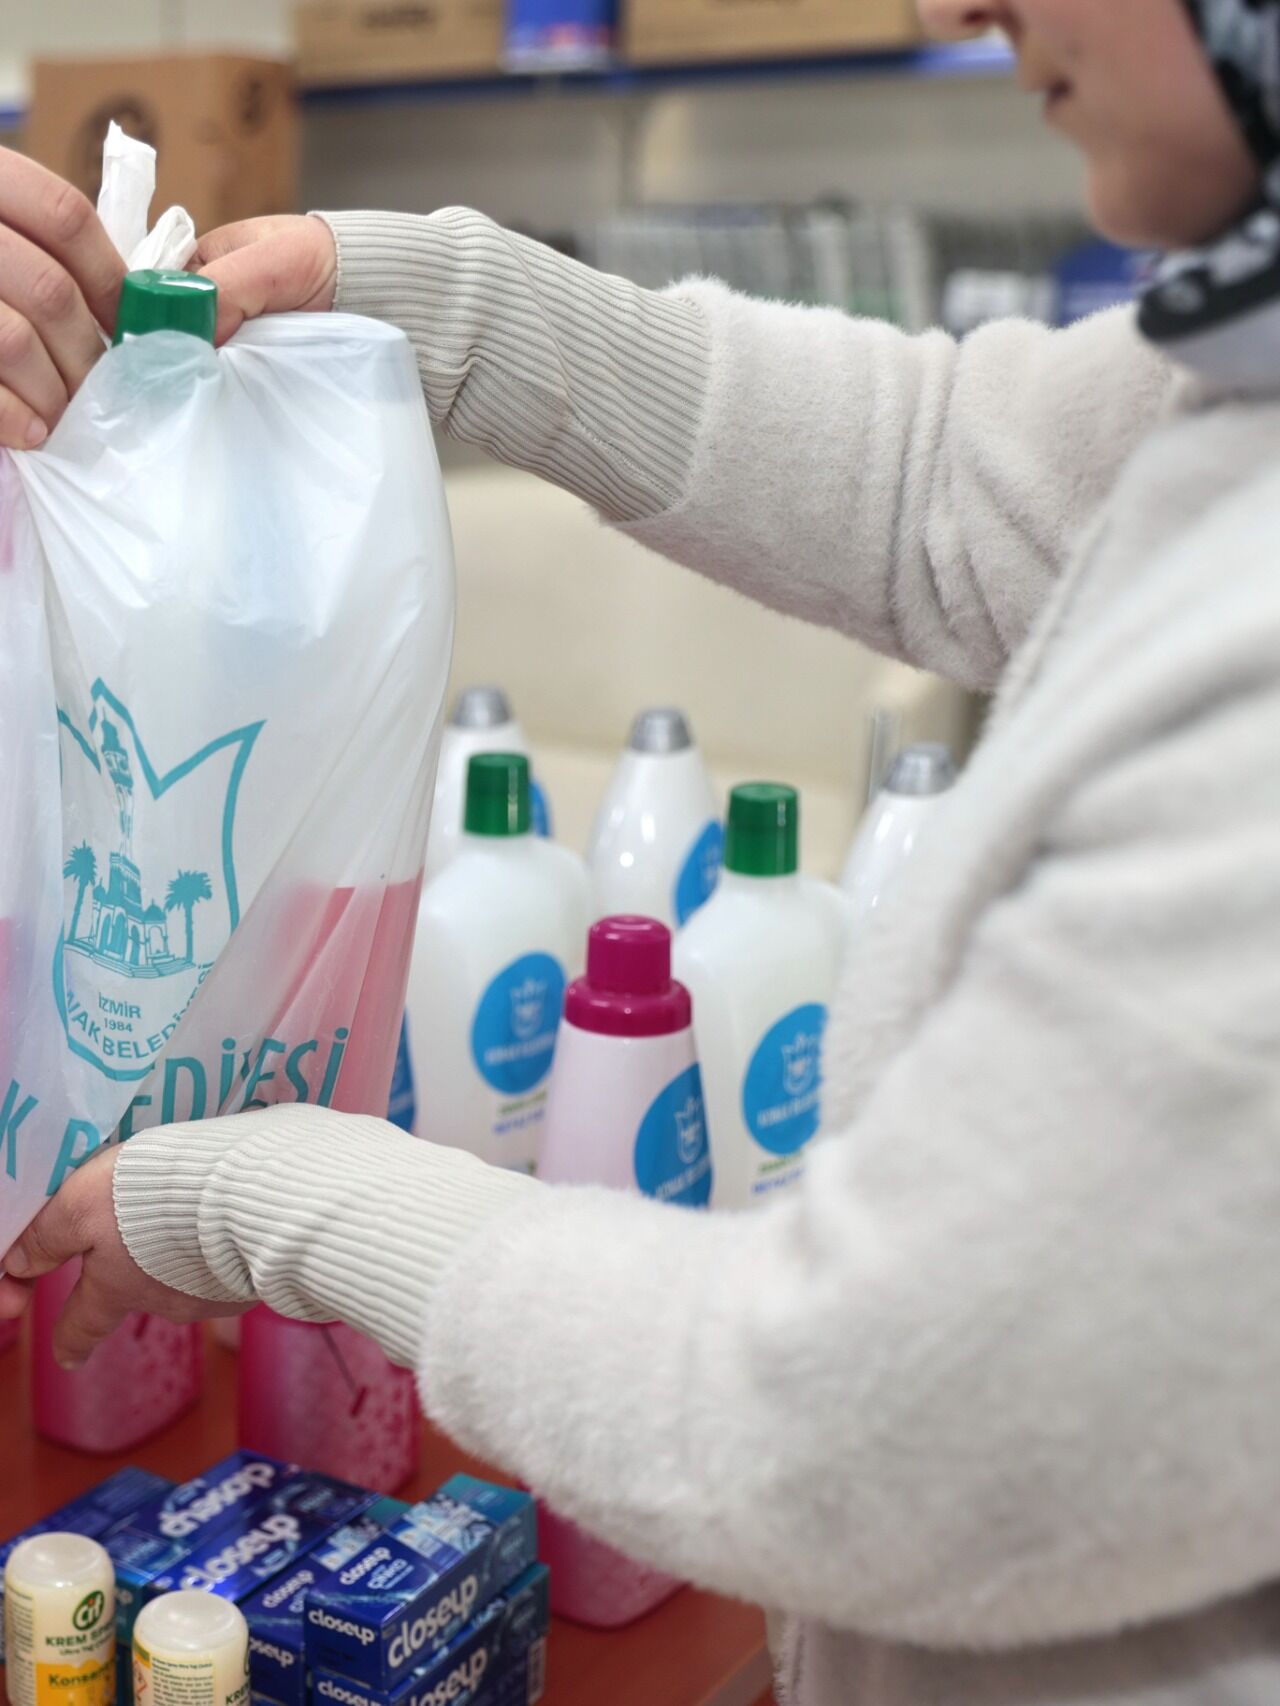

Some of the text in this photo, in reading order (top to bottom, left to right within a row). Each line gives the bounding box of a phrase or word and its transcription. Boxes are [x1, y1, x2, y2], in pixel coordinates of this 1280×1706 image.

[99, 992, 141, 1019] İZMİR
[103, 1017, 133, 1033] 1984
[160, 1461, 276, 1537] closeup
[180, 1513, 302, 1594] closeup
[339, 1547, 391, 1586] closeup
[308, 1608, 376, 1646] closeup
[388, 1574, 478, 1668] closeup
[45, 1634, 87, 1647] KREM
